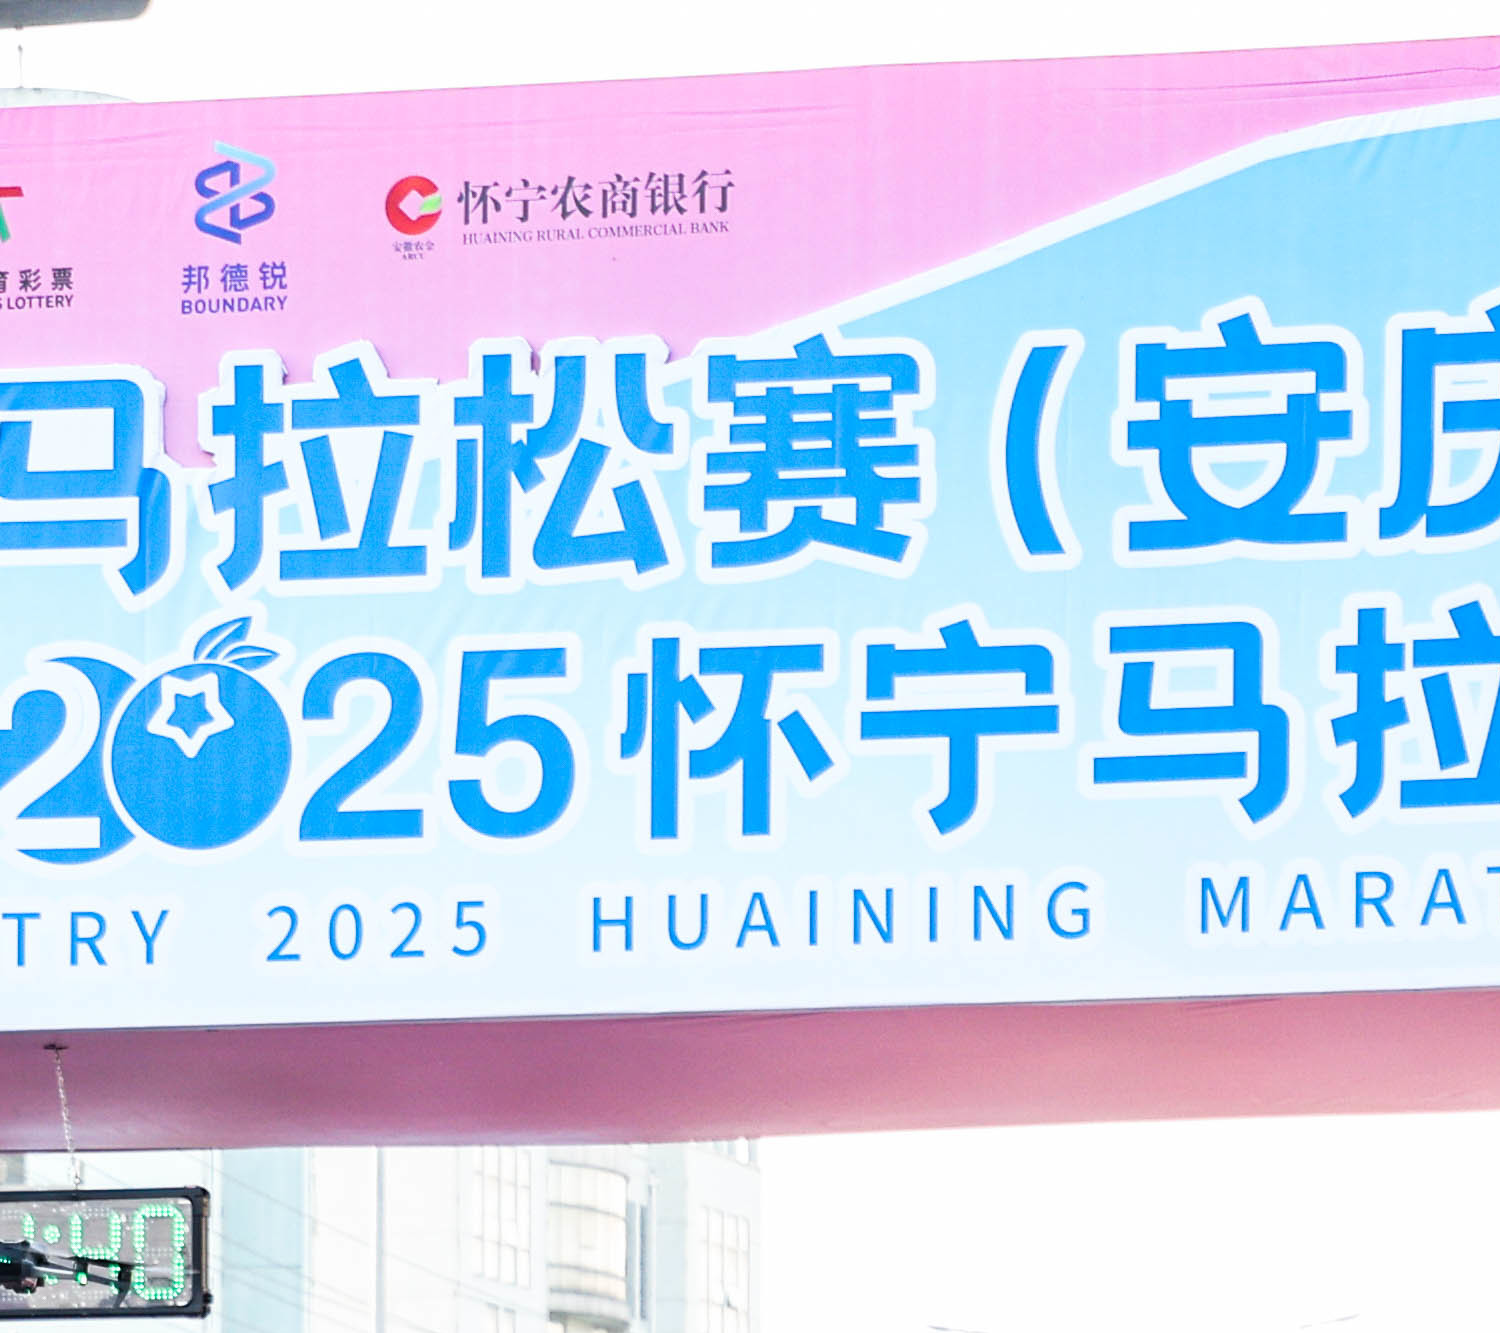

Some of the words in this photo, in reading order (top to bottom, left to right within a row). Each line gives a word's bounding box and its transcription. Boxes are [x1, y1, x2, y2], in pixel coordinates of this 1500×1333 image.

[457, 169, 734, 225] 怀宁农商银行
[462, 230, 533, 245] HUAINING
[536, 227, 584, 241] RURAL
[588, 222, 687, 239] COMMERCIAL
[690, 220, 729, 233] BANK
[181, 261, 287, 293] 邦德锐
[7, 294, 73, 311] LOTTERY
[181, 296, 288, 315] BOUNDARY
[264, 898, 490, 962] 2025
[589, 876, 1095, 954] HUAINING
